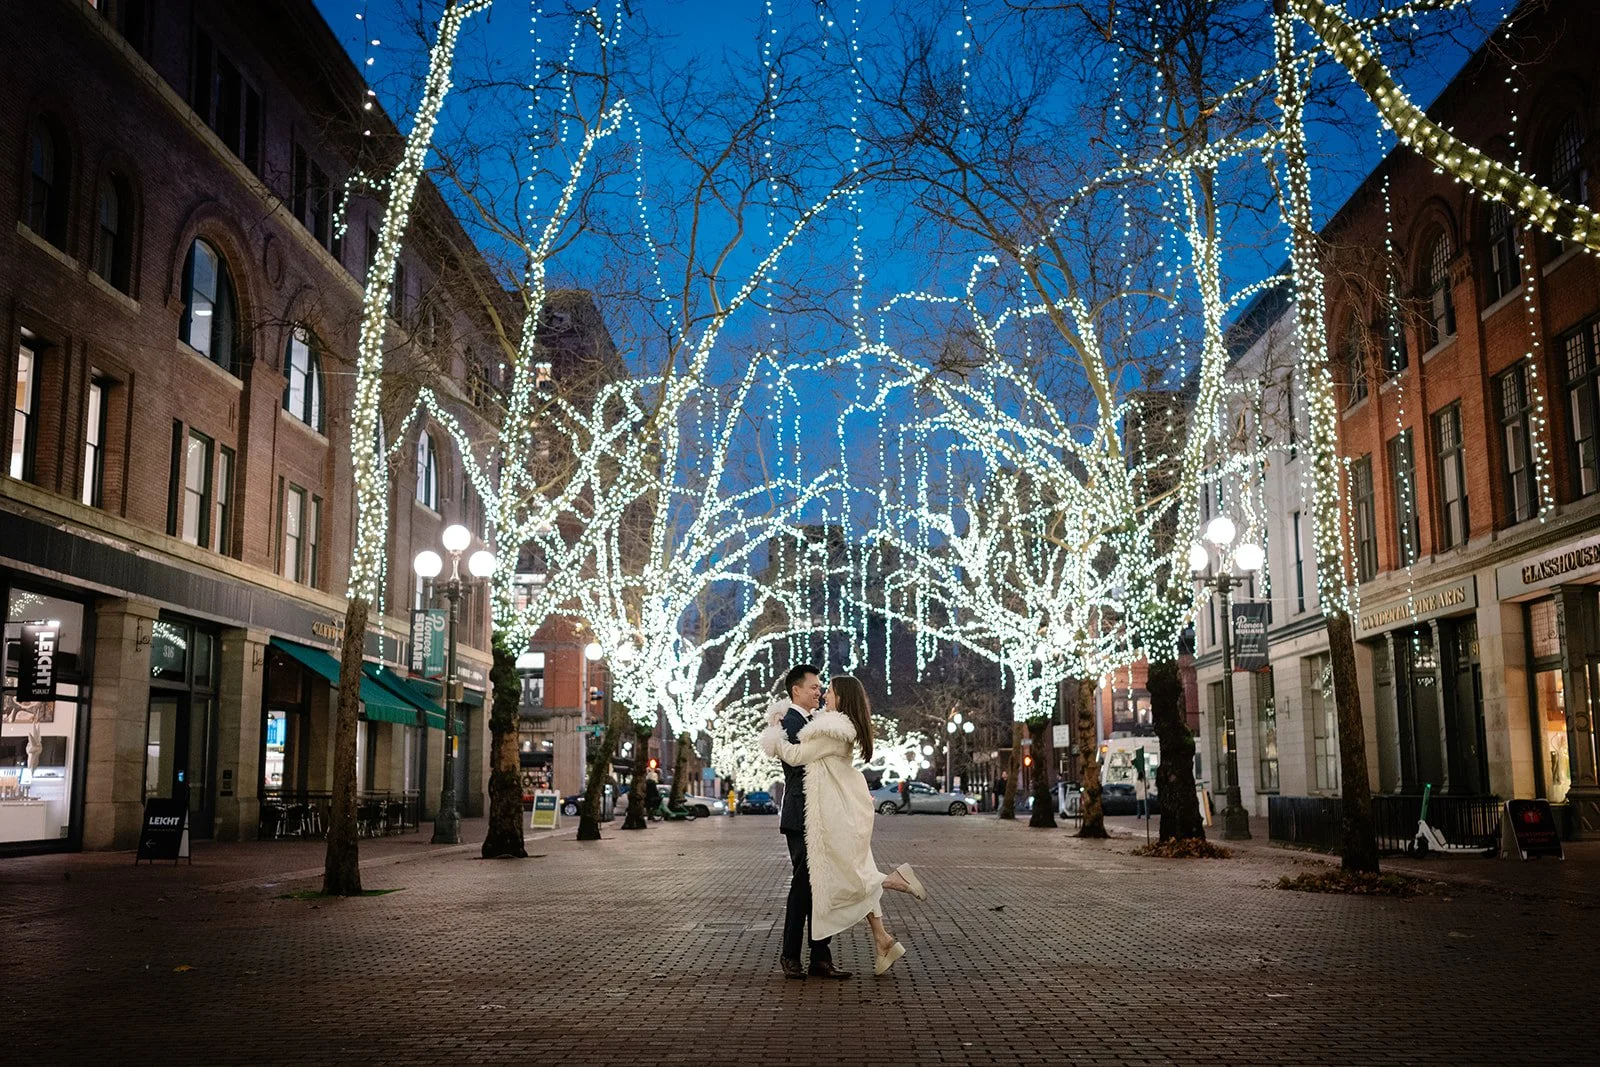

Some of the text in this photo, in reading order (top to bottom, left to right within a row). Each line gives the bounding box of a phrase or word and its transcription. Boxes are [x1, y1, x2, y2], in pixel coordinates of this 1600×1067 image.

[1522, 544, 1600, 585] GLASSHOUSE
[1439, 586, 1466, 607] ARTS
[412, 612, 425, 671] SQUARE
[423, 613, 446, 660] Pioneer
[1235, 615, 1264, 629] Pioneer
[36, 631, 56, 687] LEICHT
[149, 816, 180, 826] LEICHT
